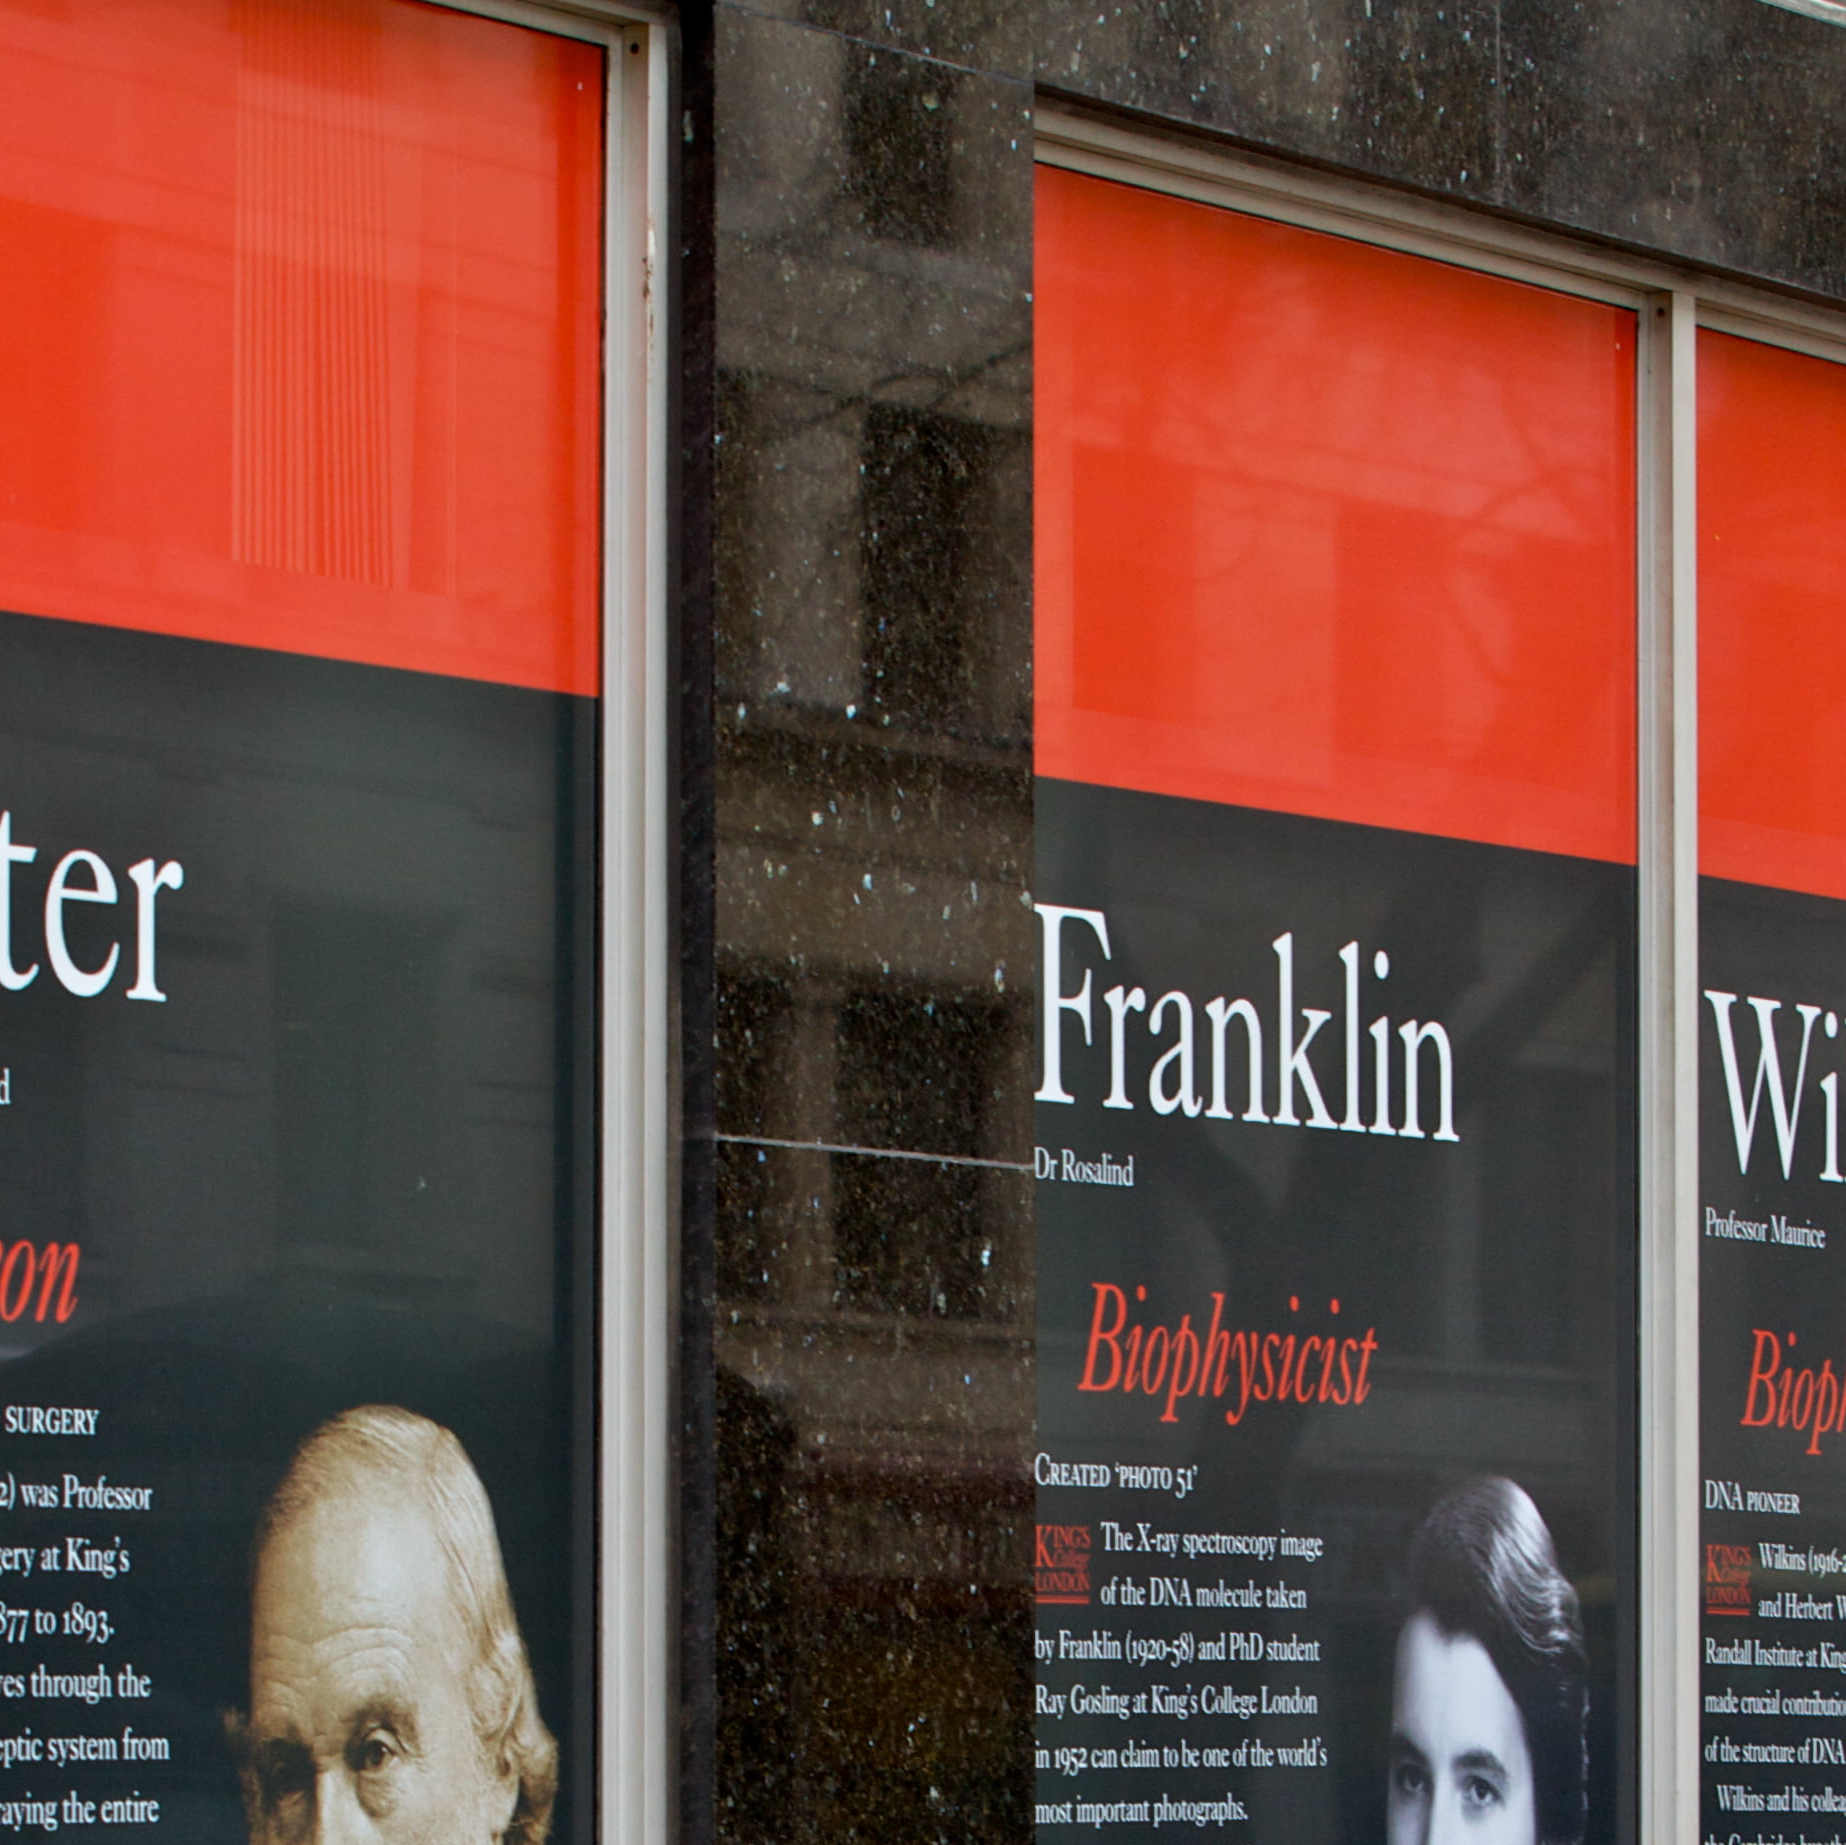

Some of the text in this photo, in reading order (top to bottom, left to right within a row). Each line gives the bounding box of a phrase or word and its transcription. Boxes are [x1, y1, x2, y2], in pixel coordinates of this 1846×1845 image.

[1034, 904, 1459, 1141] Franklin
[1034, 1147, 1133, 1186] Dr Rosalind
[1706, 1207, 1825, 1248] Professor Maurice
[1077, 1282, 1379, 1425] Biophysicist
[20, 1485, 58, 1507] was
[63, 1474, 152, 1509] Professor
[41, 1547, 60, 1570] at
[1101, 1522, 1323, 1562] The X-ray spectroscopy image
[1101, 1576, 1306, 1608] of the DNA molecule taken
[35, 1609, 56, 1634] to
[63, 1602, 113, 1643] 1893.
[1036, 1630, 1320, 1667] by Franklin (1920-58) and PhD student
[30, 1664, 111, 1704] through
[118, 1664, 150, 1697] the
[48, 1736, 117, 1767] system
[122, 1726, 169, 1760] from
[62, 1790, 95, 1823] the
[101, 1791, 159, 1823] entire
